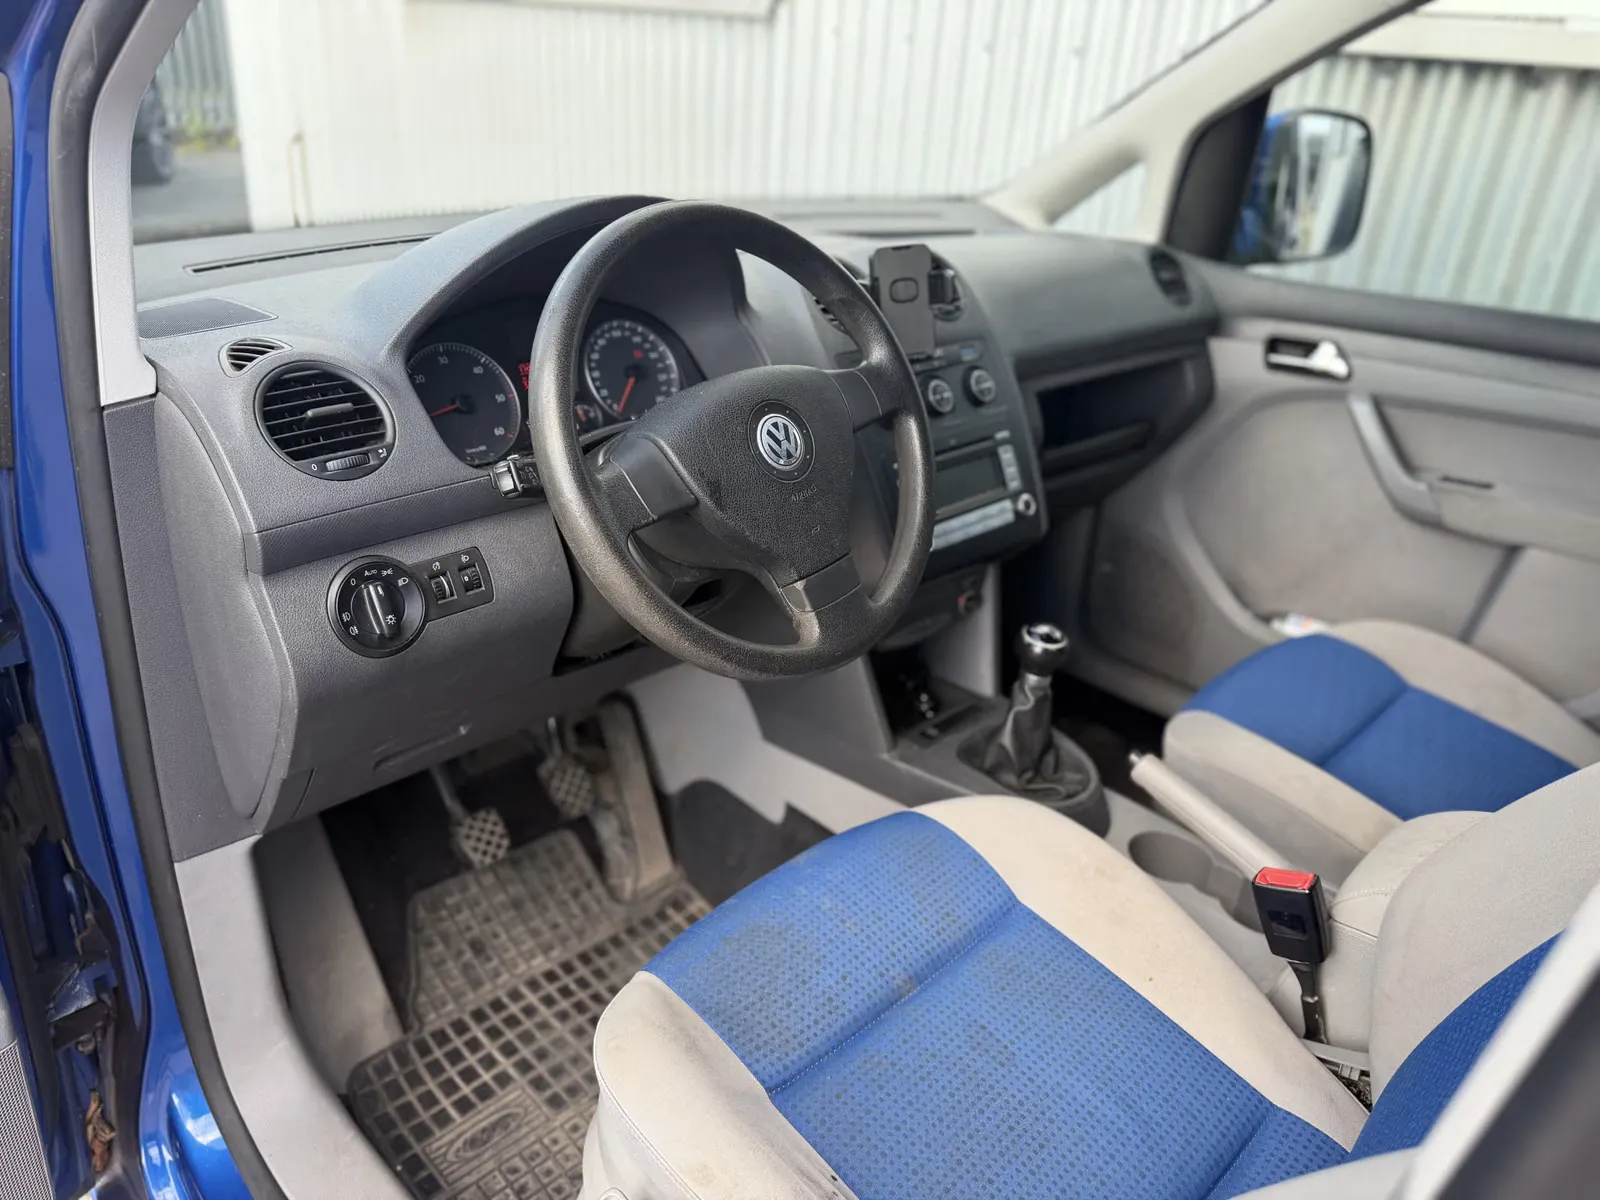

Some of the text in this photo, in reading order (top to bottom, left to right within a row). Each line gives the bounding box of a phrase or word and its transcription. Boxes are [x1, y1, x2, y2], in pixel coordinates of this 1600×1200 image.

[414, 374, 425, 384] 20
[494, 426, 505, 436] 60
[790, 484, 818, 502] AIRBAG
[350, 578, 356, 586] 0
